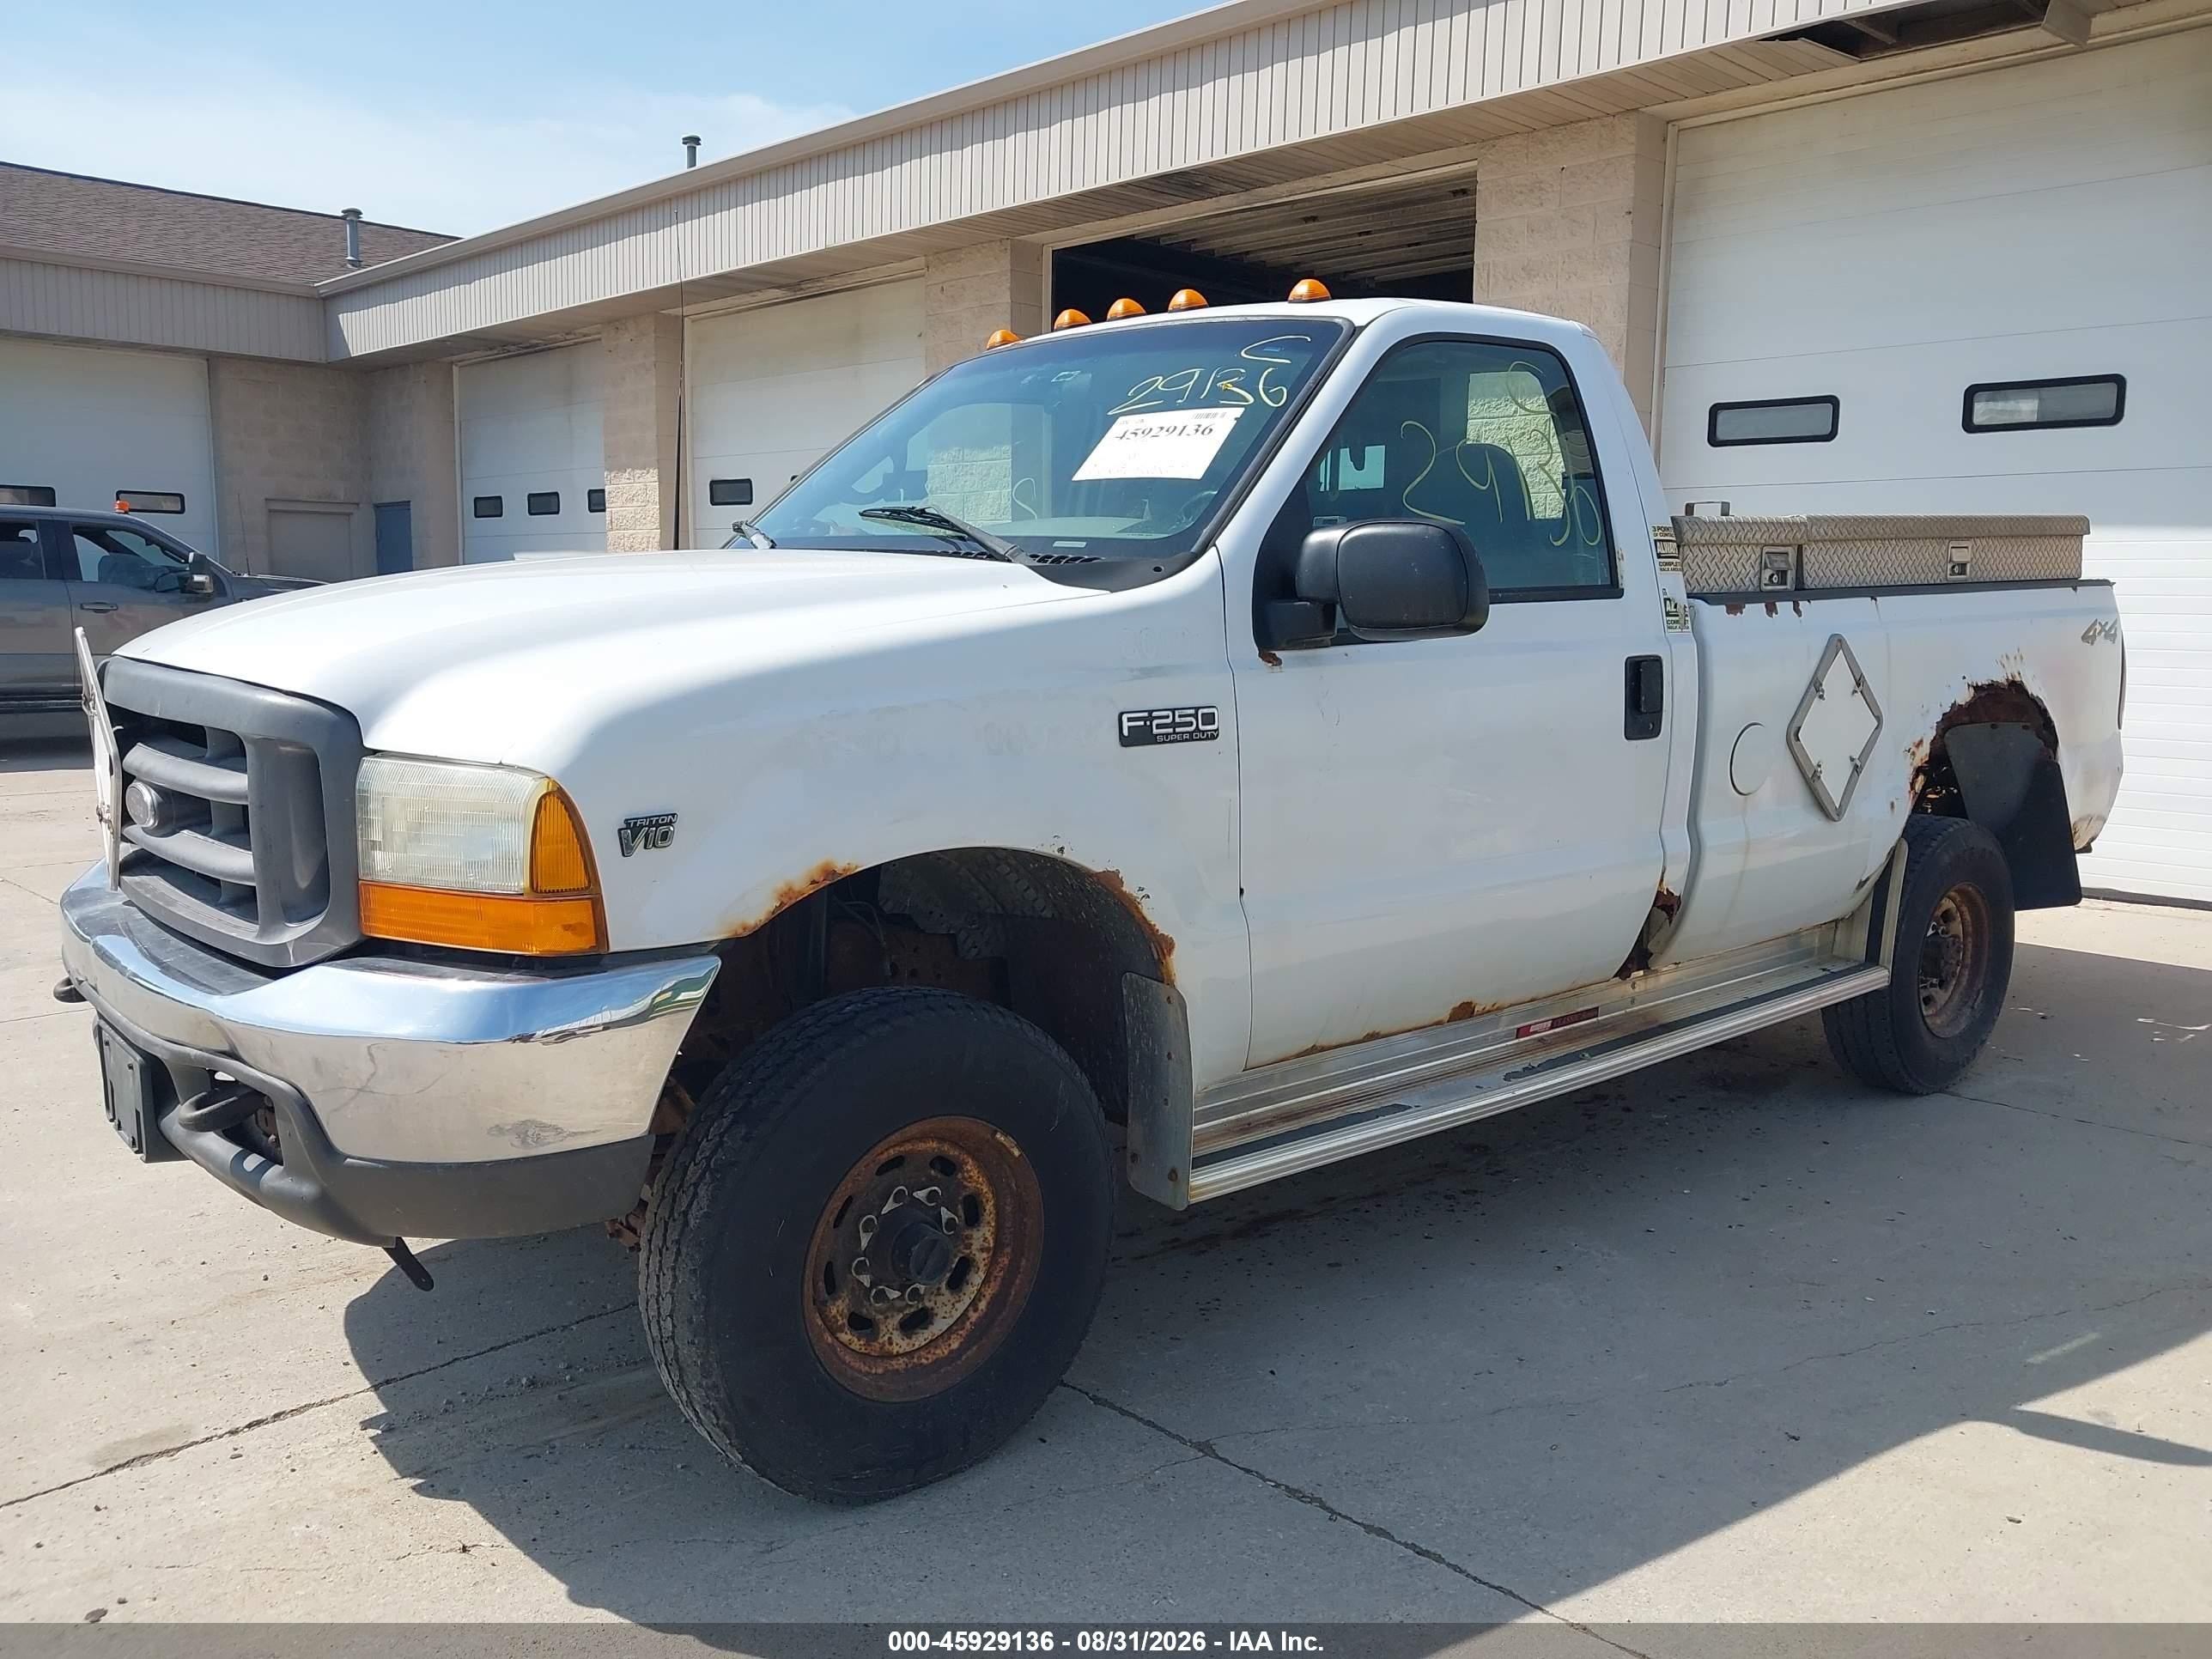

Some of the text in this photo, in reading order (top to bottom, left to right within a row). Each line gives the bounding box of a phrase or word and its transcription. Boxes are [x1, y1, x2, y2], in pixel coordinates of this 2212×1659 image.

[1107, 367, 1288, 416] 29136
[1115, 423, 1216, 441] 45929136
[1656, 541, 1679, 555] ALWAY
[1156, 730, 1218, 743] SUPER DUTY
[627, 814, 678, 828] TRITON
[618, 824, 675, 857] V10
